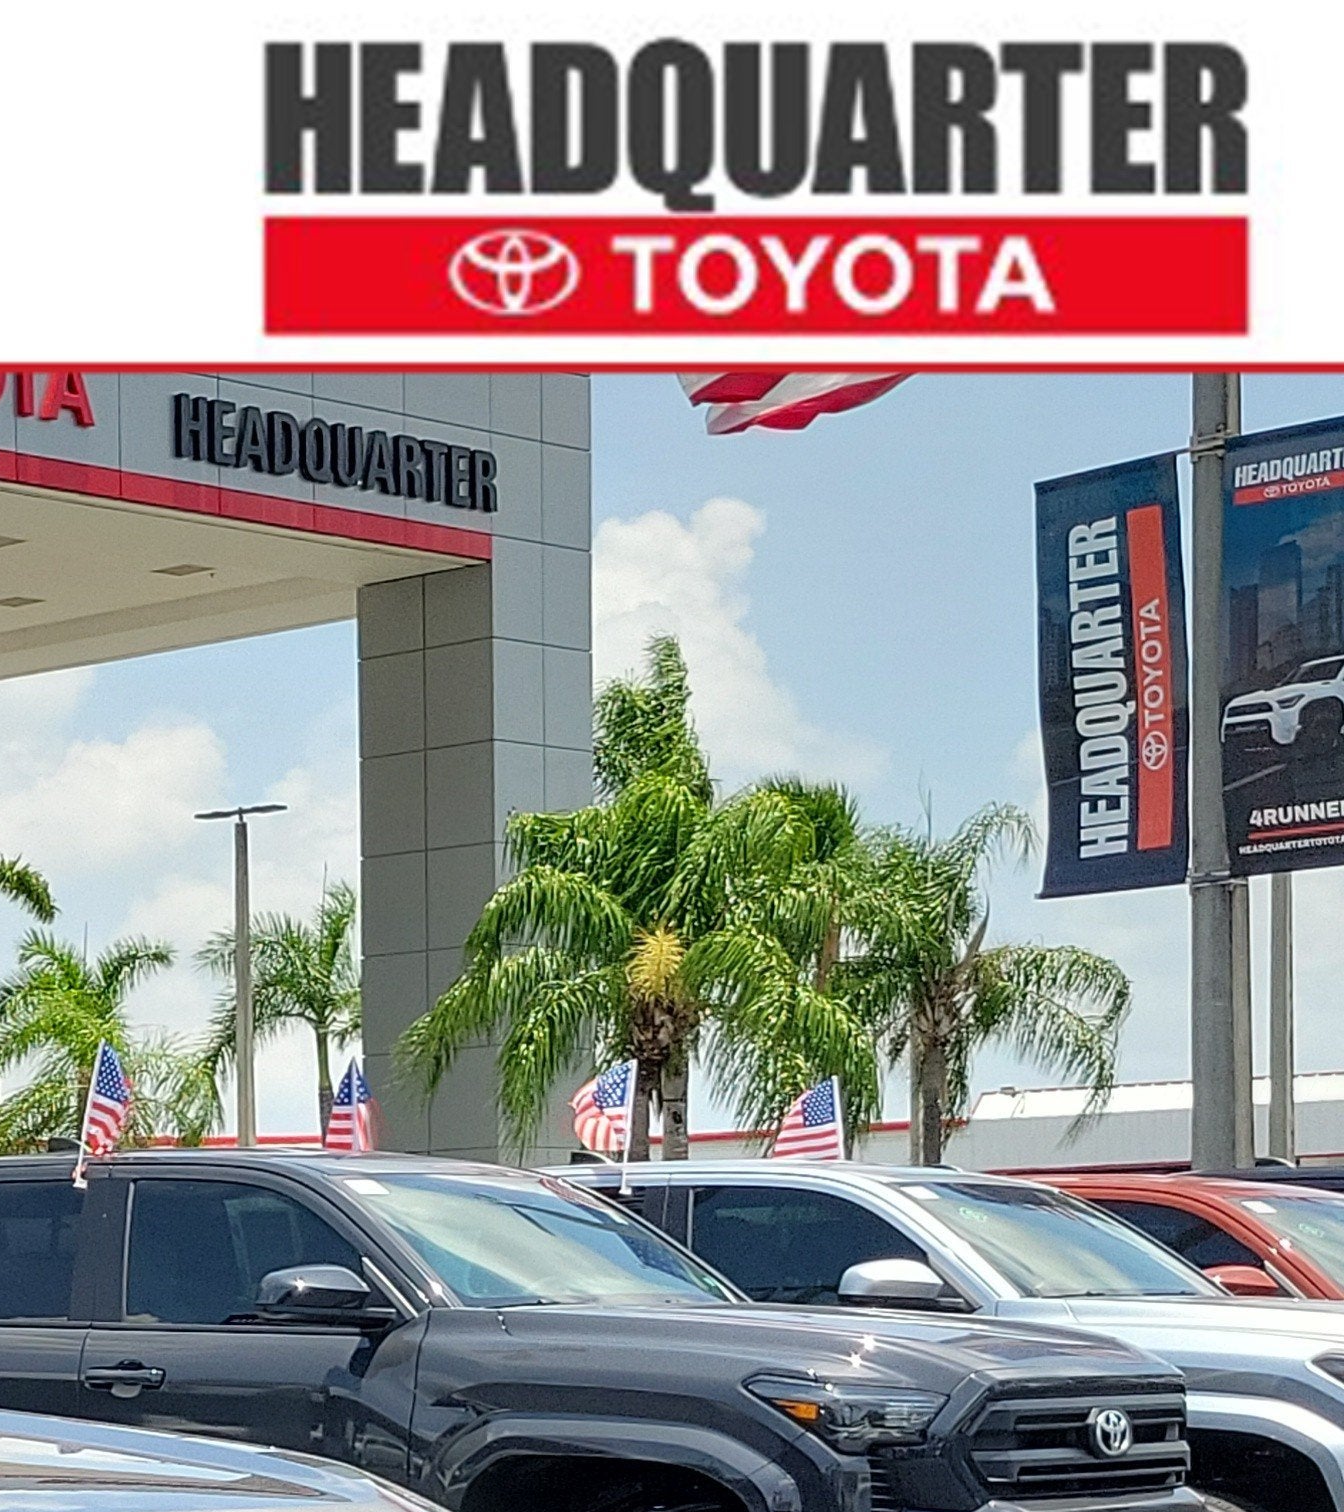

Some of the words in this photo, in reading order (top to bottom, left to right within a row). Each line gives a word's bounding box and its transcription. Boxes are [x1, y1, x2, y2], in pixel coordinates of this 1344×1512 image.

[173, 393, 499, 513] HEADQUARTER
[1234, 447, 1344, 488] HEADQUART
[1281, 476, 1331, 494] TOYOTA
[1068, 516, 1136, 859] HEADQUARTER
[1139, 598, 1165, 728] TOYOTA
[1249, 800, 1344, 828] 4RUNNE
